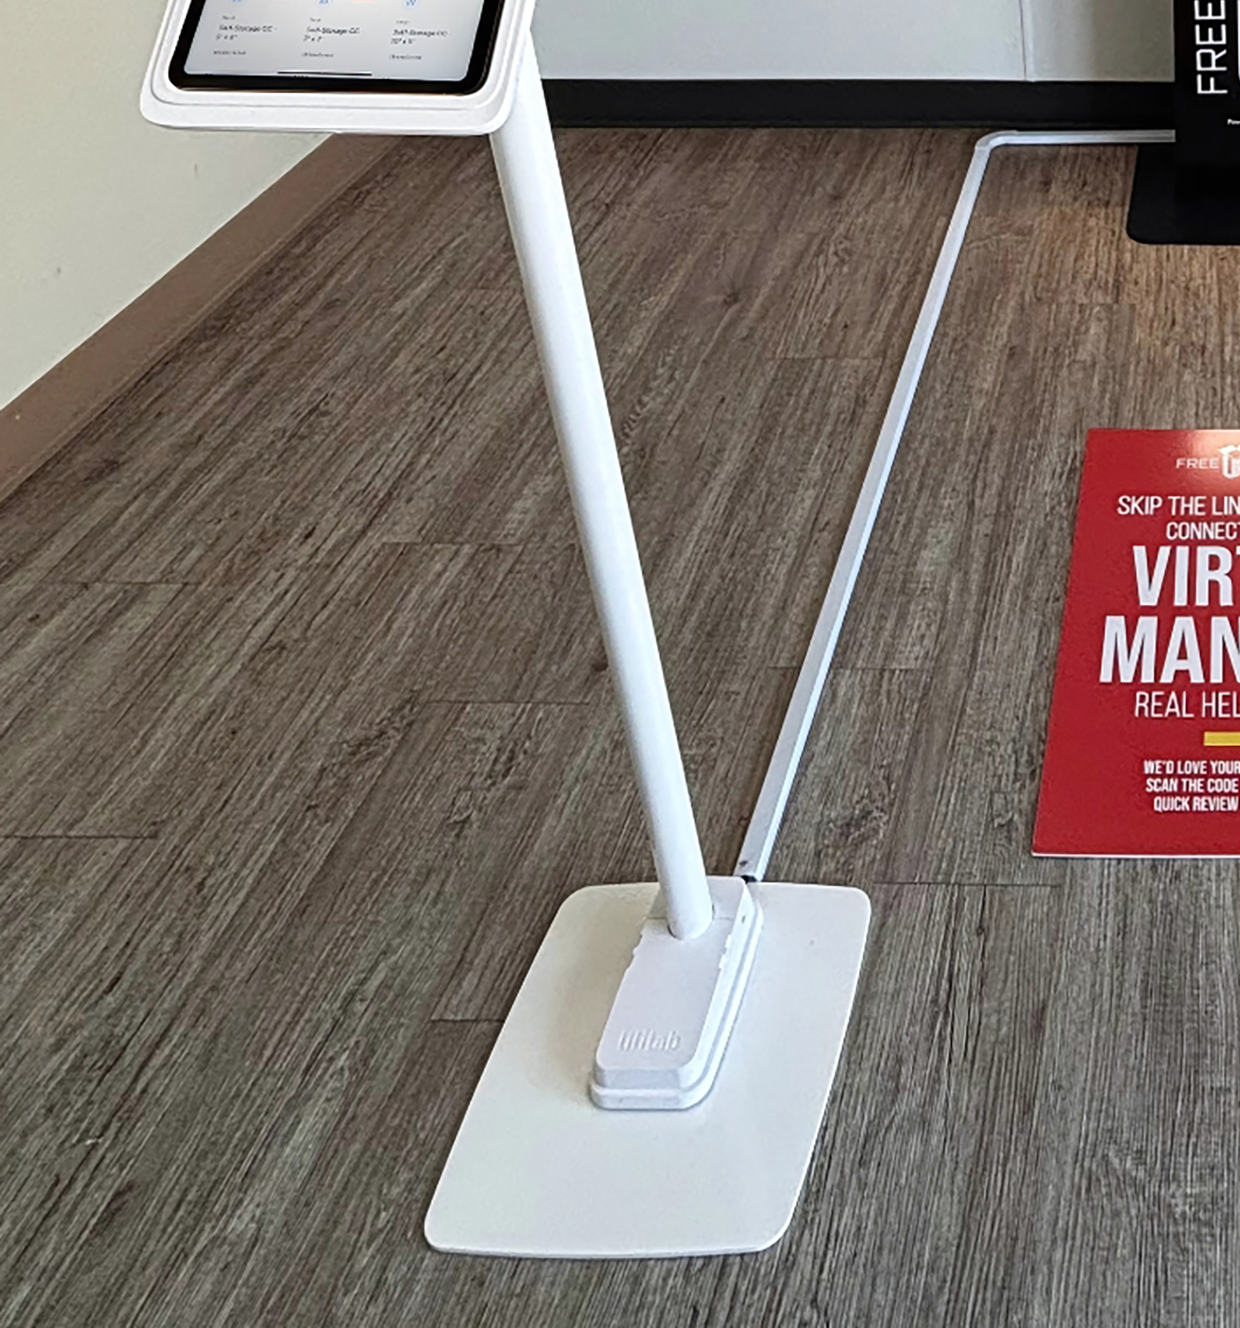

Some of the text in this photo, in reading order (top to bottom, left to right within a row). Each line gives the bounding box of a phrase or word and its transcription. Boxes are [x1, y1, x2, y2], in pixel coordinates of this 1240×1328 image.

[1194, 0, 1228, 95] FREE
[1175, 458, 1220, 469] FREE
[1117, 495, 1162, 515] SKIP
[1168, 495, 1207, 515] THE
[1134, 690, 1195, 718] REAL
[1143, 760, 1175, 775] WE'D
[1177, 760, 1208, 775] LOVE
[1146, 777, 1178, 792] SCAN
[1181, 777, 1204, 792] THE
[1207, 777, 1239, 792] CODE
[1153, 796, 1190, 813] QUICK
[1192, 796, 1240, 811] REVIEW
